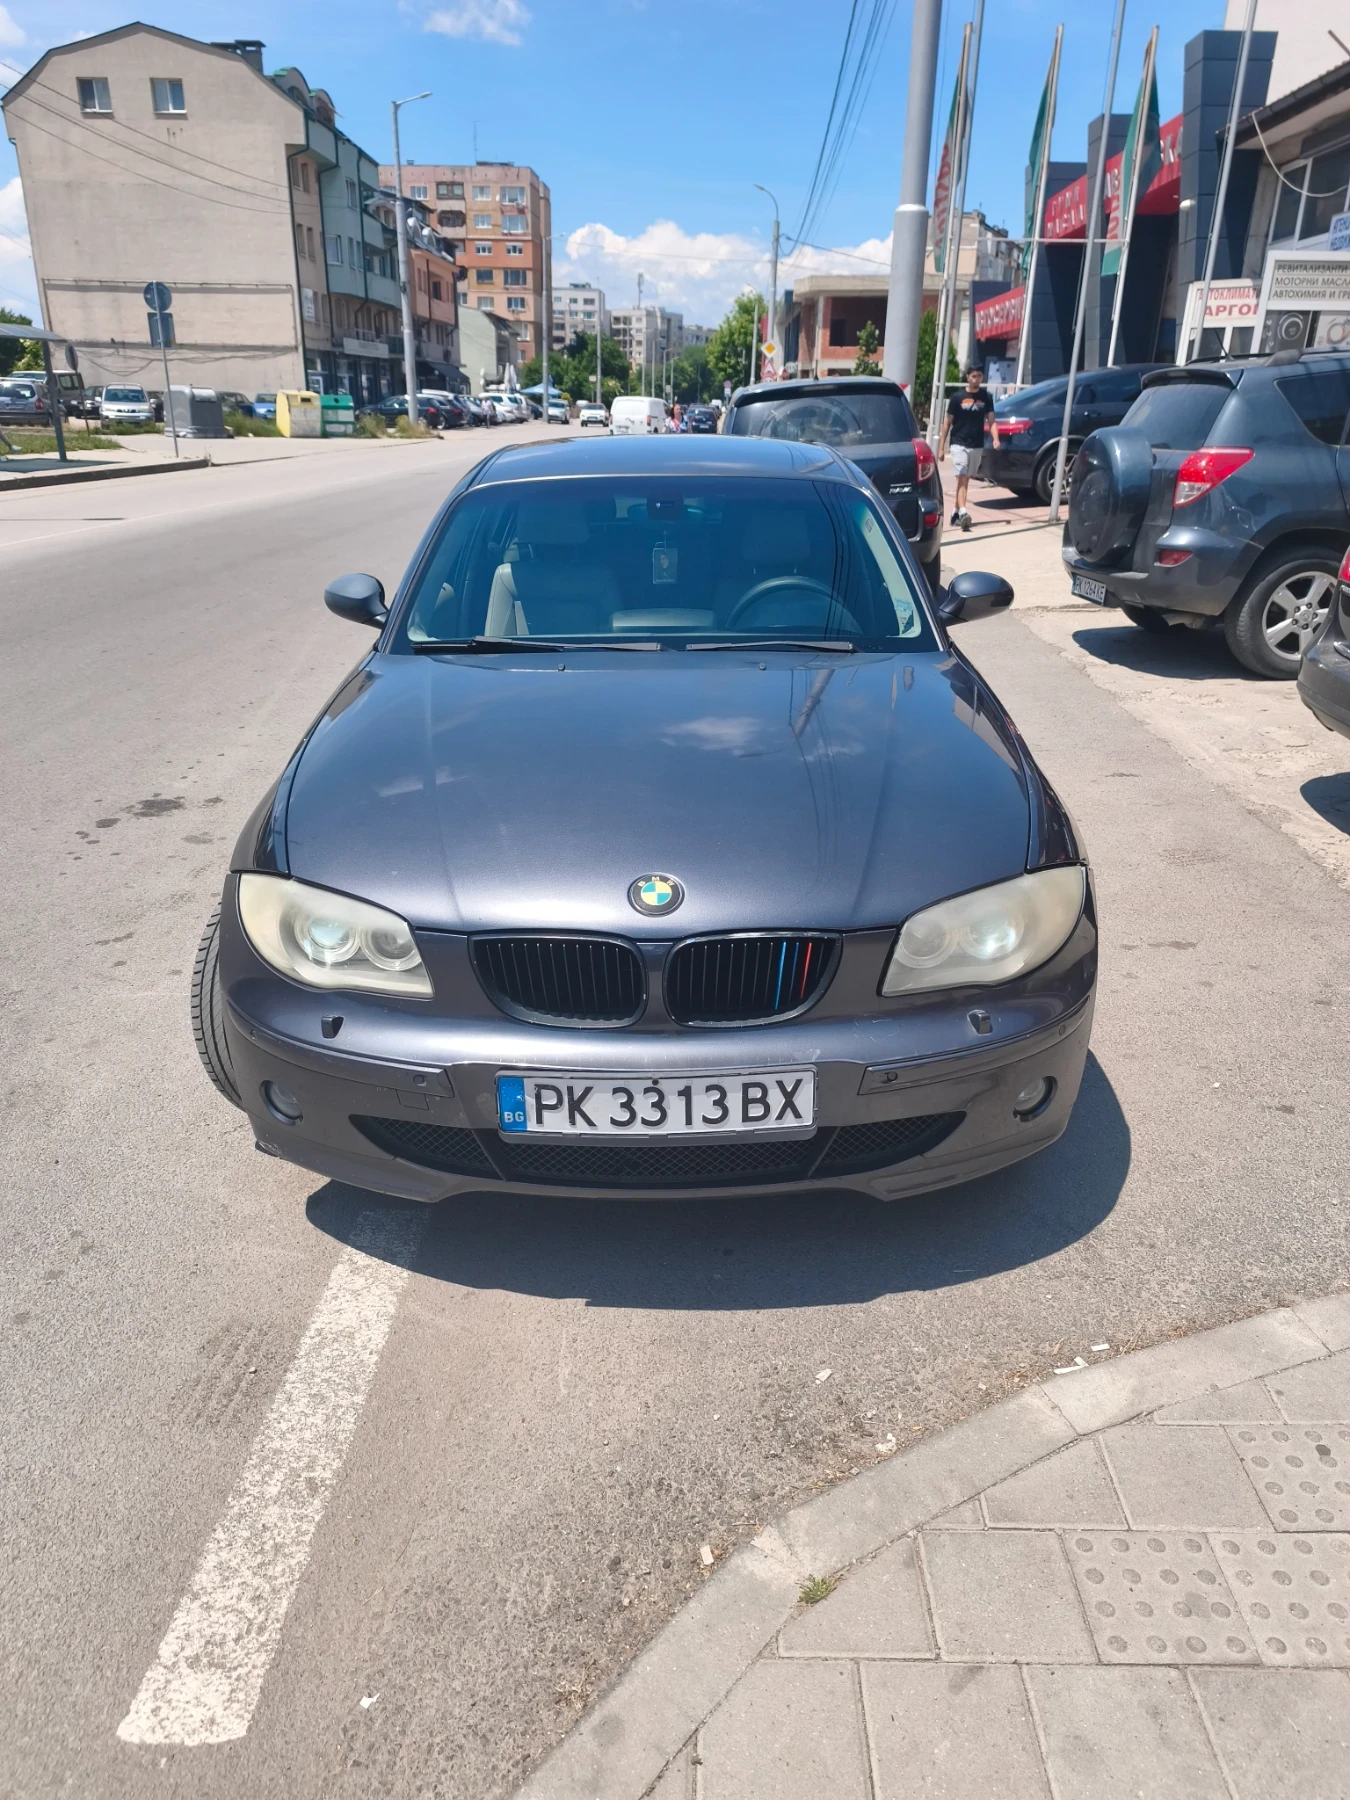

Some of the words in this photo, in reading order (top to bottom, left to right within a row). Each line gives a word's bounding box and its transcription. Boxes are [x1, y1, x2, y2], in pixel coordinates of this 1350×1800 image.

[1277, 264, 1348, 274] РЕВИТАЛИЗАНТИ
[1275, 277, 1319, 286] МОТОРНИ
[1272, 289, 1327, 299] АВТОХИМИЯ
[1329, 290, 1336, 299] И
[503, 1110, 525, 1123] BG
[534, 1083, 597, 1127] PK
[609, 1083, 729, 1127] 3313
[741, 1078, 804, 1123] BX
